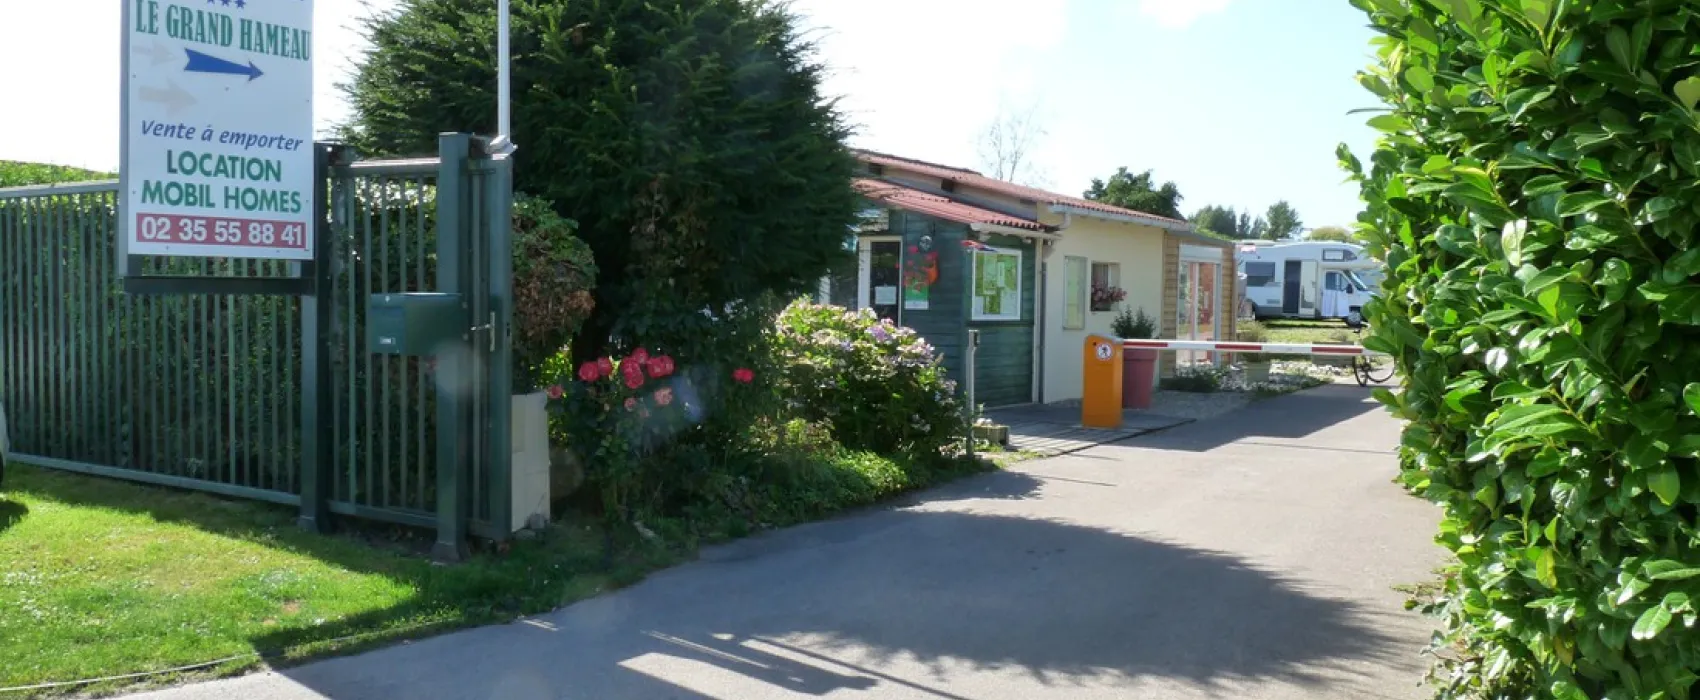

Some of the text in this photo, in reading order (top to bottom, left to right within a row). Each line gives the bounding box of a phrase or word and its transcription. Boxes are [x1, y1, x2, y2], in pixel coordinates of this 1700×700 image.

[135, 0, 312, 61] LE GRAND HAMEAU
[141, 120, 196, 141] Vente
[219, 129, 303, 151] emporter
[166, 149, 282, 182] LOCATION
[141, 180, 302, 214] MOBIL HOMES
[141, 217, 303, 246] 02 35 55 88 41
